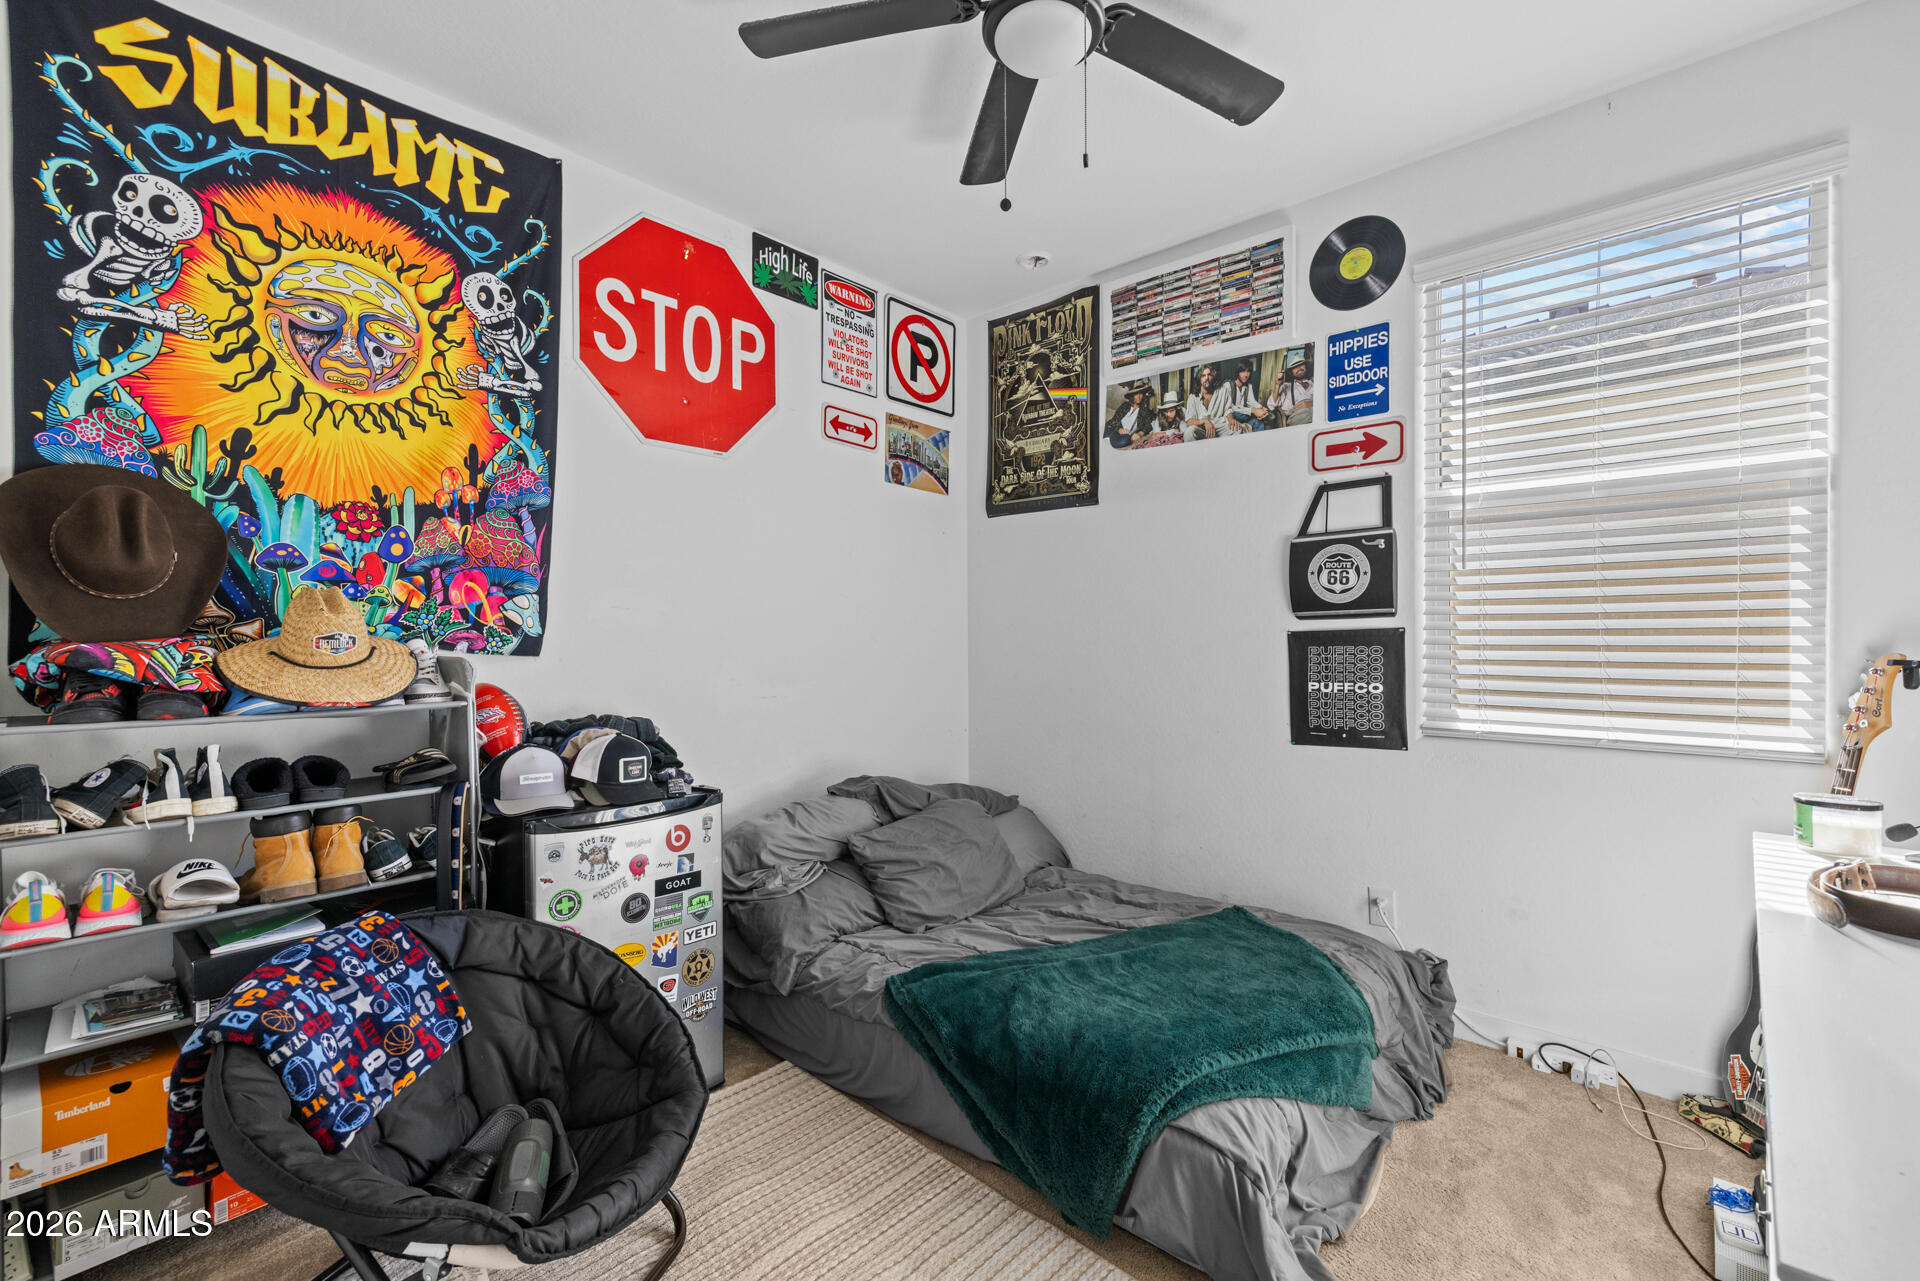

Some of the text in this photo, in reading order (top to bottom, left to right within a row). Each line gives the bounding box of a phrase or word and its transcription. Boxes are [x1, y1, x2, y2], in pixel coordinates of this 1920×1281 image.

[93, 17, 510, 213] SUBLIME
[759, 247, 813, 284] High Life
[827, 284, 872, 308] WARNING
[845, 309, 855, 320] NO
[594, 277, 765, 390] STOP
[826, 312, 874, 338] TRESPASSING
[993, 296, 1093, 358] PINK FLOYD
[833, 328, 869, 348] VIOLATORS
[1329, 331, 1388, 357] HIPPIES
[828, 338, 872, 360] WILL BE SHOT
[832, 350, 869, 369] SURVIVORS
[1344, 354, 1372, 370] USE
[828, 360, 872, 381] WILL BE SHOT
[1329, 366, 1388, 389] SIDEDOOR
[840, 374, 861, 388] AGAIN
[1347, 401, 1378, 411] Exceptions
[1001, 464, 1081, 484] DARK SIDE OF THE MOON
[1325, 561, 1352, 569] ROUTE
[1327, 569, 1350, 585] 66
[1308, 682, 1384, 693] PUFFCO
[184, 861, 215, 870] NIKE
[666, 877, 692, 890] GOAT
[686, 924, 714, 941] YETI
[682, 994, 699, 1011] WILD
[700, 988, 717, 1001] WEST
[54, 1097, 111, 1121] Timberland
